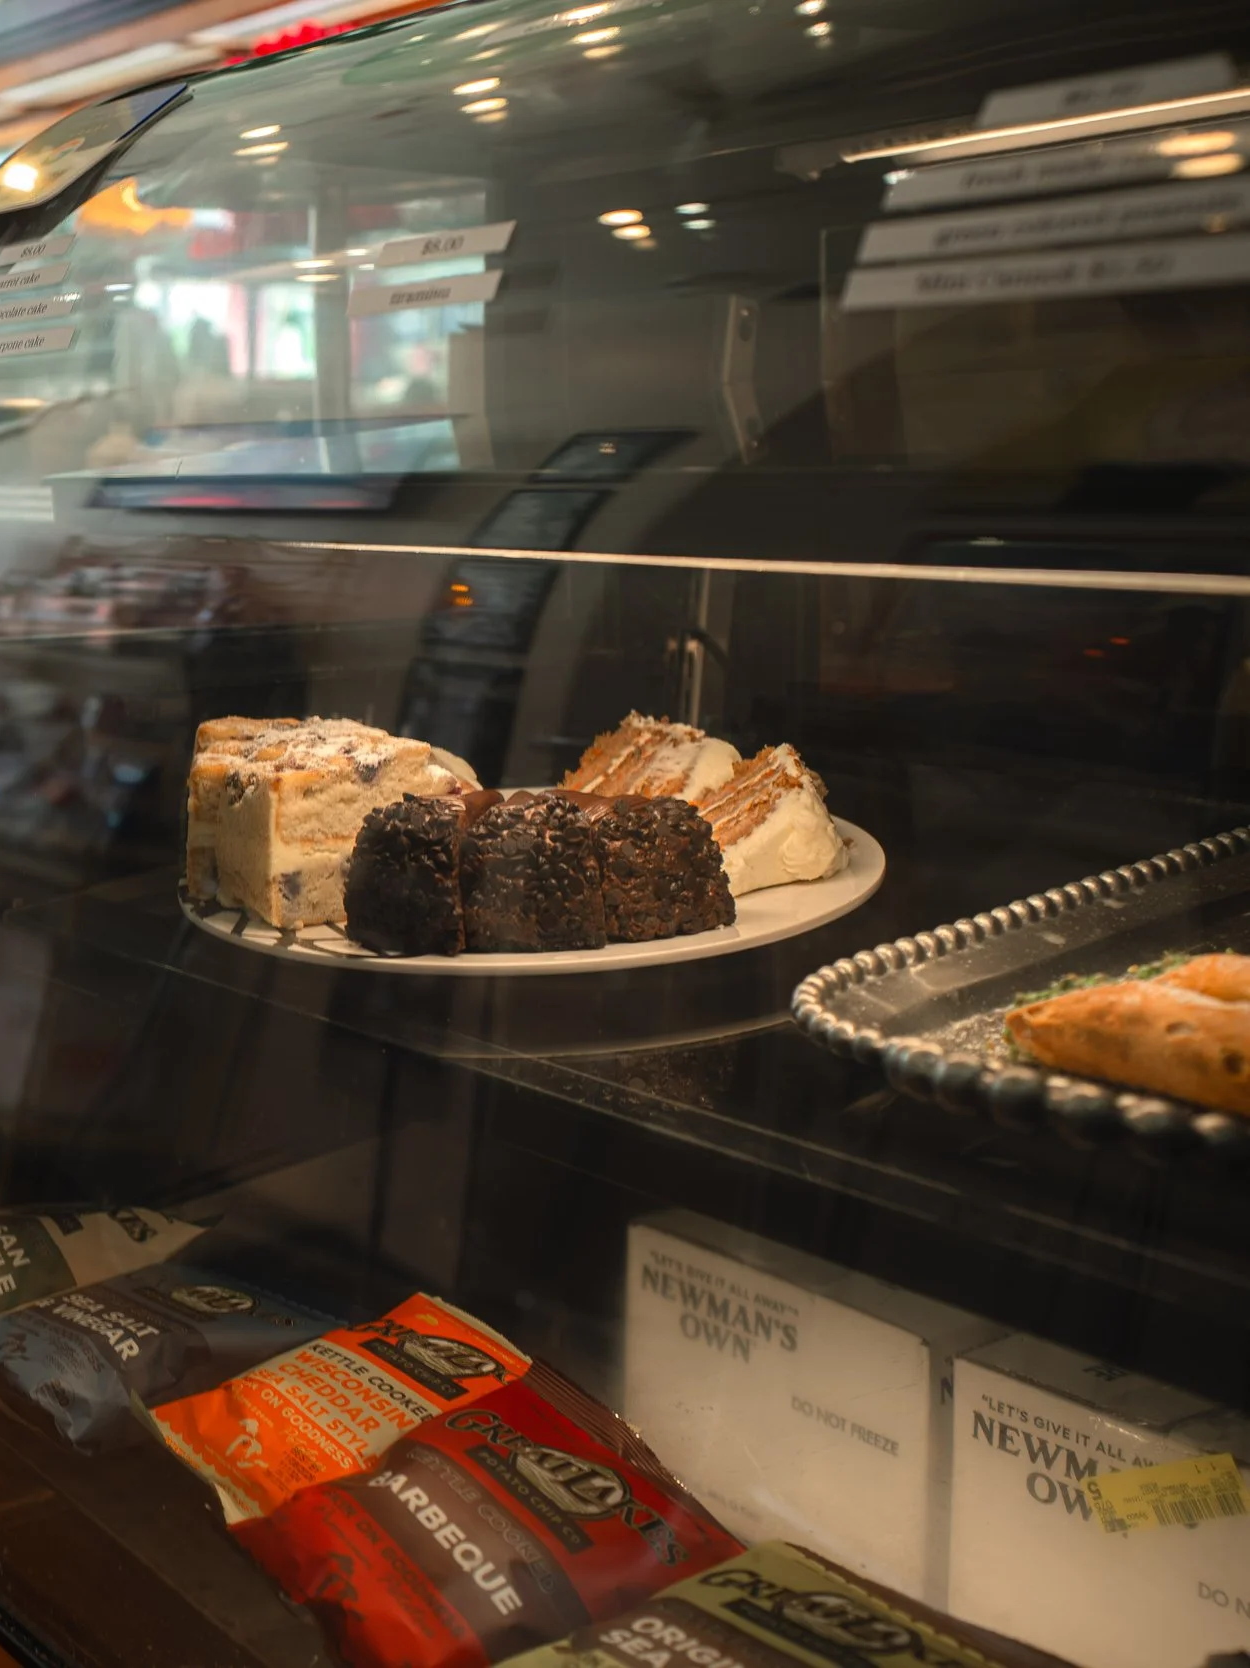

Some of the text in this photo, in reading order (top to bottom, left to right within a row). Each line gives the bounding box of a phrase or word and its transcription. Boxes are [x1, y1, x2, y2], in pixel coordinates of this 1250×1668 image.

[19, 272, 41, 287] cake
[27, 302, 48, 317] cake
[23, 335, 45, 350] cake
[53, 1303, 140, 1361] VINEGAR
[102, 1312, 161, 1338] SALT
[641, 1263, 798, 1352] NEWMAN'S
[309, 1343, 369, 1377] KETTLE
[679, 1312, 750, 1365] OWN
[278, 1362, 381, 1434] CHEDDAR
[285, 1383, 332, 1418] SALT
[295, 1351, 415, 1430] WISCONSIN
[260, 1388, 283, 1408] ON
[282, 1407, 353, 1469] GOODNESS
[791, 1394, 900, 1457] DO NOT FREEZE
[971, 1410, 1098, 1483] NEWM
[1034, 1417, 1070, 1440] GIVE
[1075, 1431, 1091, 1445] IT
[1096, 1439, 1127, 1463] ALL
[477, 1451, 530, 1495] POTATO
[530, 1496, 563, 1524] CHIP
[1026, 1471, 1093, 1522] OW
[1198, 1581, 1230, 1608] DO
[599, 1628, 672, 1668] SEA
